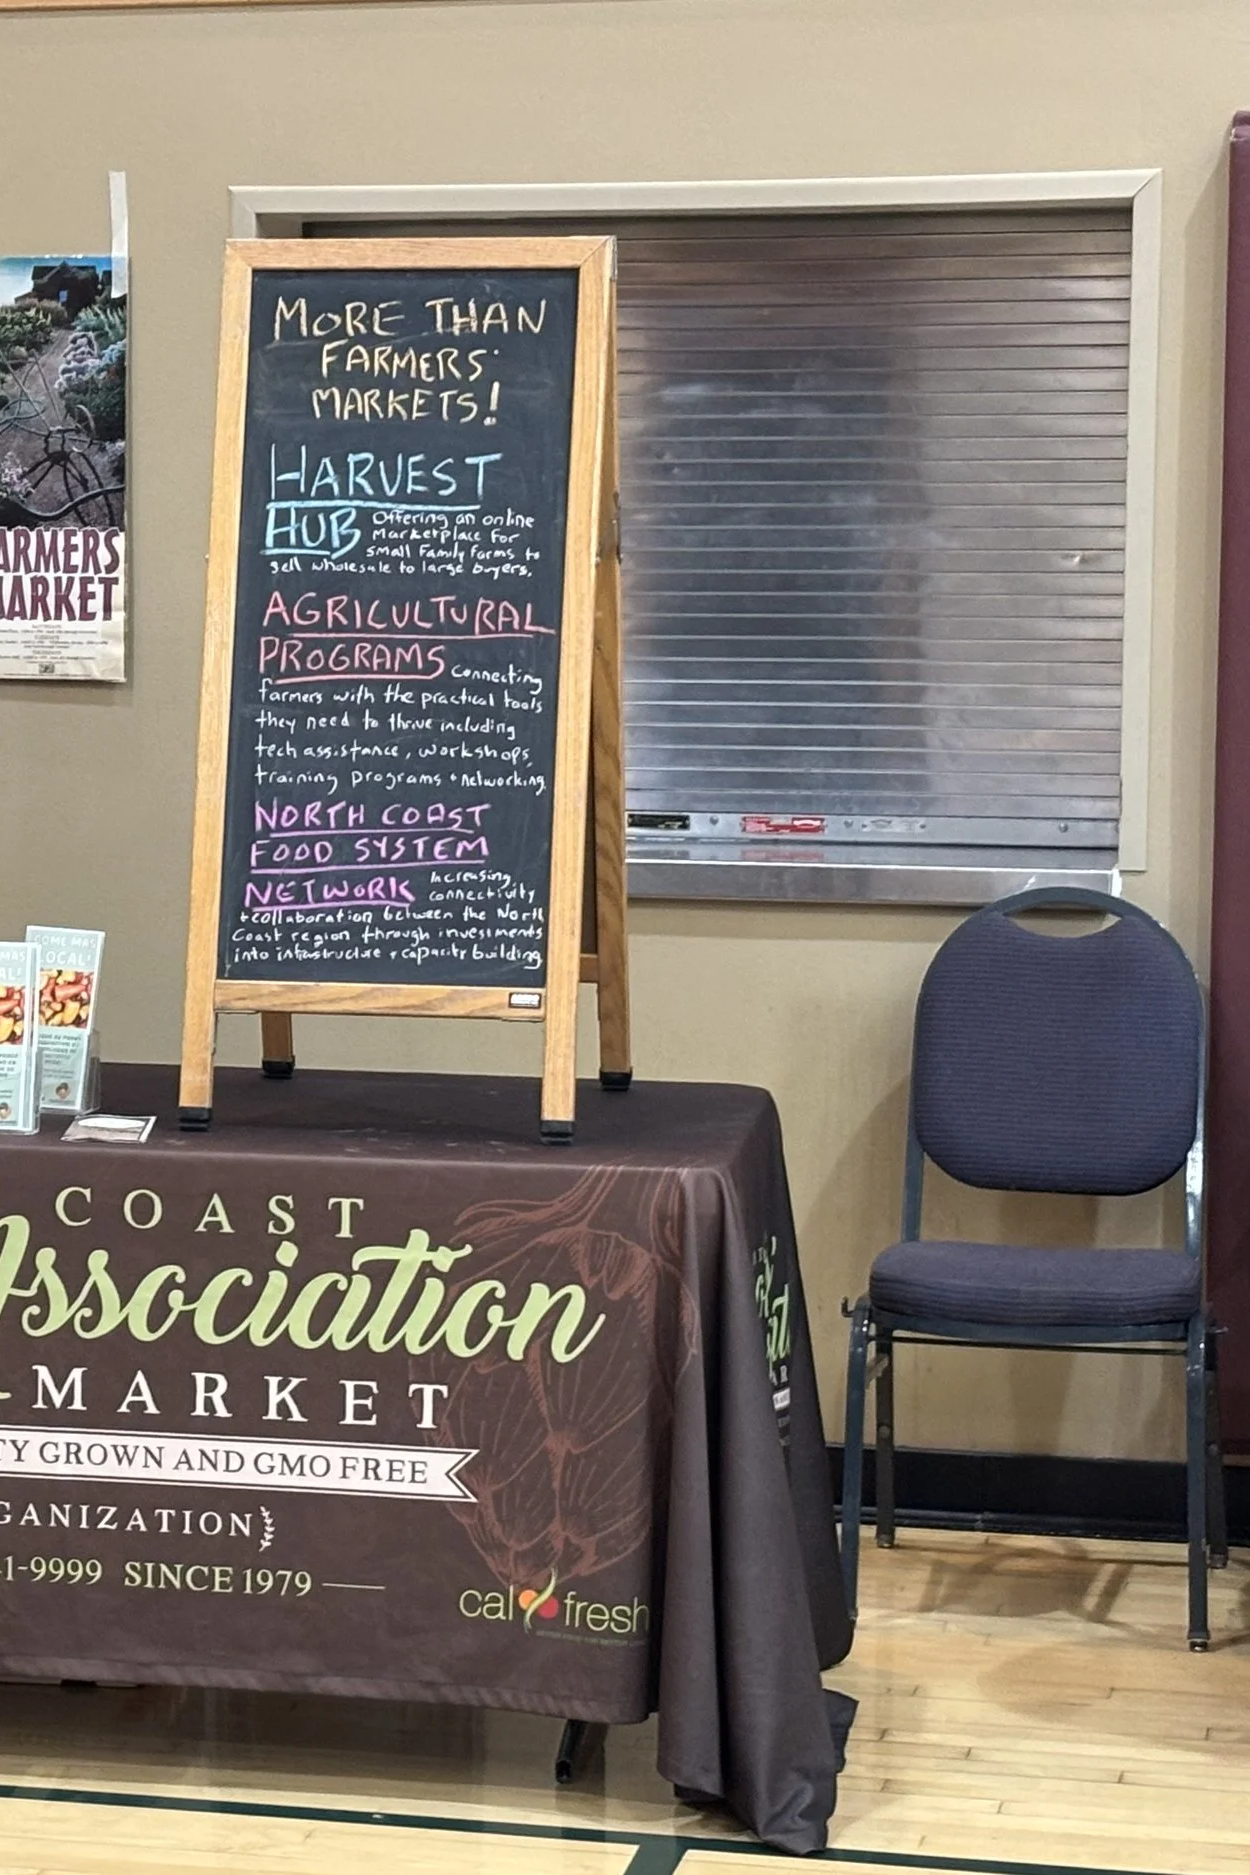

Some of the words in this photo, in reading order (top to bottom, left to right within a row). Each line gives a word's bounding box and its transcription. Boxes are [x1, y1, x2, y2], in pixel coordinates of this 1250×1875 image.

[273, 296, 404, 341] MORE
[425, 298, 547, 335] THAN
[312, 382, 500, 427] MARKETS!
[270, 444, 503, 500] HARVEST
[264, 507, 362, 560] HUB
[372, 511, 448, 529] Offering
[455, 515, 475, 526] an
[482, 509, 535, 528] online
[270, 557, 302, 574] sell
[312, 559, 392, 573] wholesale
[400, 561, 415, 574] to
[422, 561, 463, 576] large
[526, 550, 541, 561] to
[263, 591, 557, 635] AGRICULTURAL
[258, 636, 447, 677] PROGRAMS
[258, 678, 322, 704] farmers
[333, 684, 375, 704] with
[384, 683, 415, 704] the
[422, 688, 494, 709] practical
[504, 690, 543, 713] tools
[255, 710, 296, 734] they
[306, 712, 350, 728] need
[362, 708, 378, 730] to
[388, 713, 432, 732] thrive
[440, 718, 516, 740] including
[254, 734, 297, 758] tech
[254, 764, 338, 795] training
[351, 770, 442, 789] programs
[254, 798, 365, 831] NORTH
[381, 803, 492, 833] COAST
[250, 839, 333, 868] FOOD
[355, 837, 490, 862] SYSTEM
[244, 876, 416, 907] NETWORK
[431, 870, 511, 889] Increasing
[429, 882, 535, 904] connectivity
[383, 906, 454, 923] between
[463, 906, 486, 922] the
[497, 903, 544, 924] North
[232, 927, 283, 942] Coast
[291, 930, 350, 948] region
[362, 926, 431, 947] through
[438, 925, 543, 940] investments
[233, 948, 269, 963] into
[401, 946, 468, 961] capacity
[55, 1186, 364, 1239] COAST
[31, 1365, 449, 1429] MARKET
[38, 1442, 164, 1469] GROWN
[173, 1448, 246, 1475] AND
[253, 1452, 331, 1479] GMO
[339, 1457, 428, 1484] FREE
[123, 1561, 234, 1593] SINCE
[243, 1567, 313, 1596] 1979
[459, 1584, 514, 1621] cal
[564, 1592, 649, 1633] fresh
